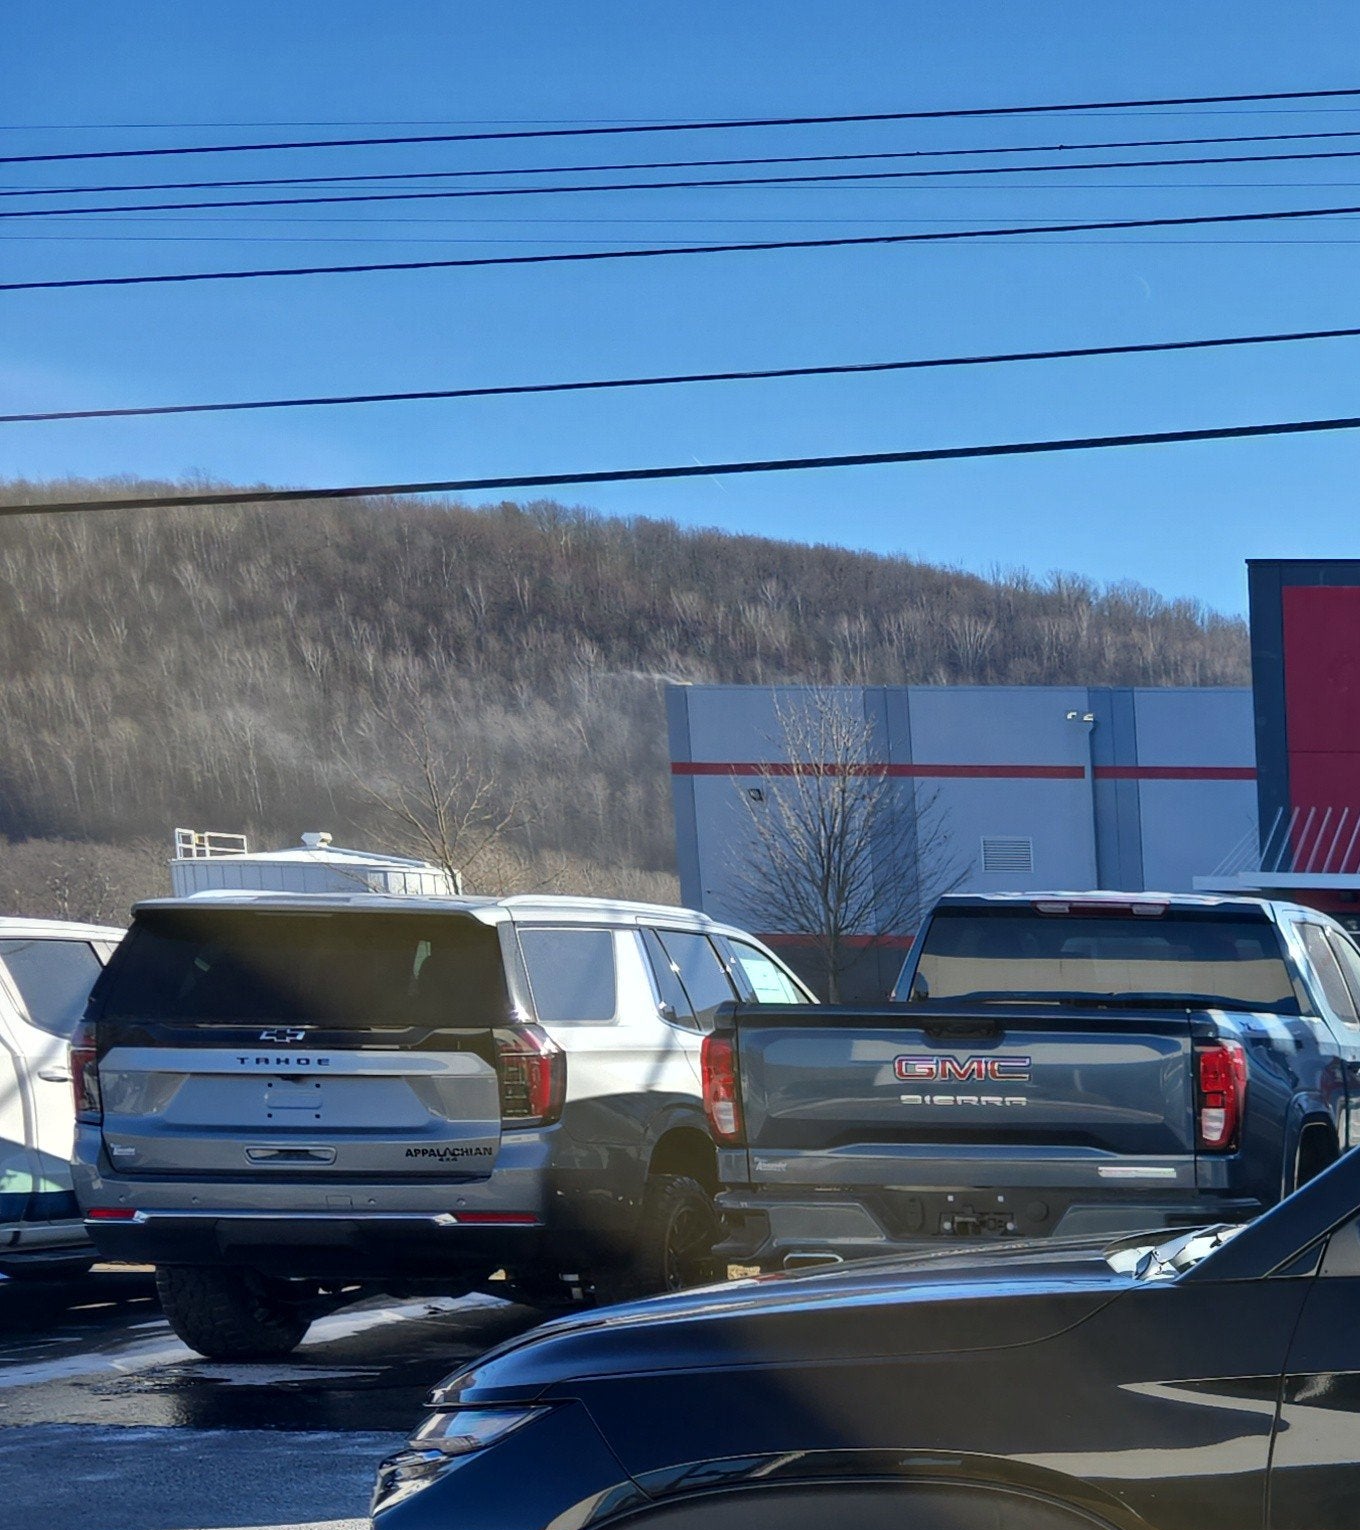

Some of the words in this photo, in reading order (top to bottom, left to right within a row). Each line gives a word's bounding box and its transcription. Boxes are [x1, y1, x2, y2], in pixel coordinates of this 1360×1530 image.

[236, 1057, 330, 1066] TAHOE
[892, 1055, 1031, 1082] GMC
[900, 1094, 1028, 1106] SIERRA
[405, 1147, 493, 1157] APPALACHIAN
